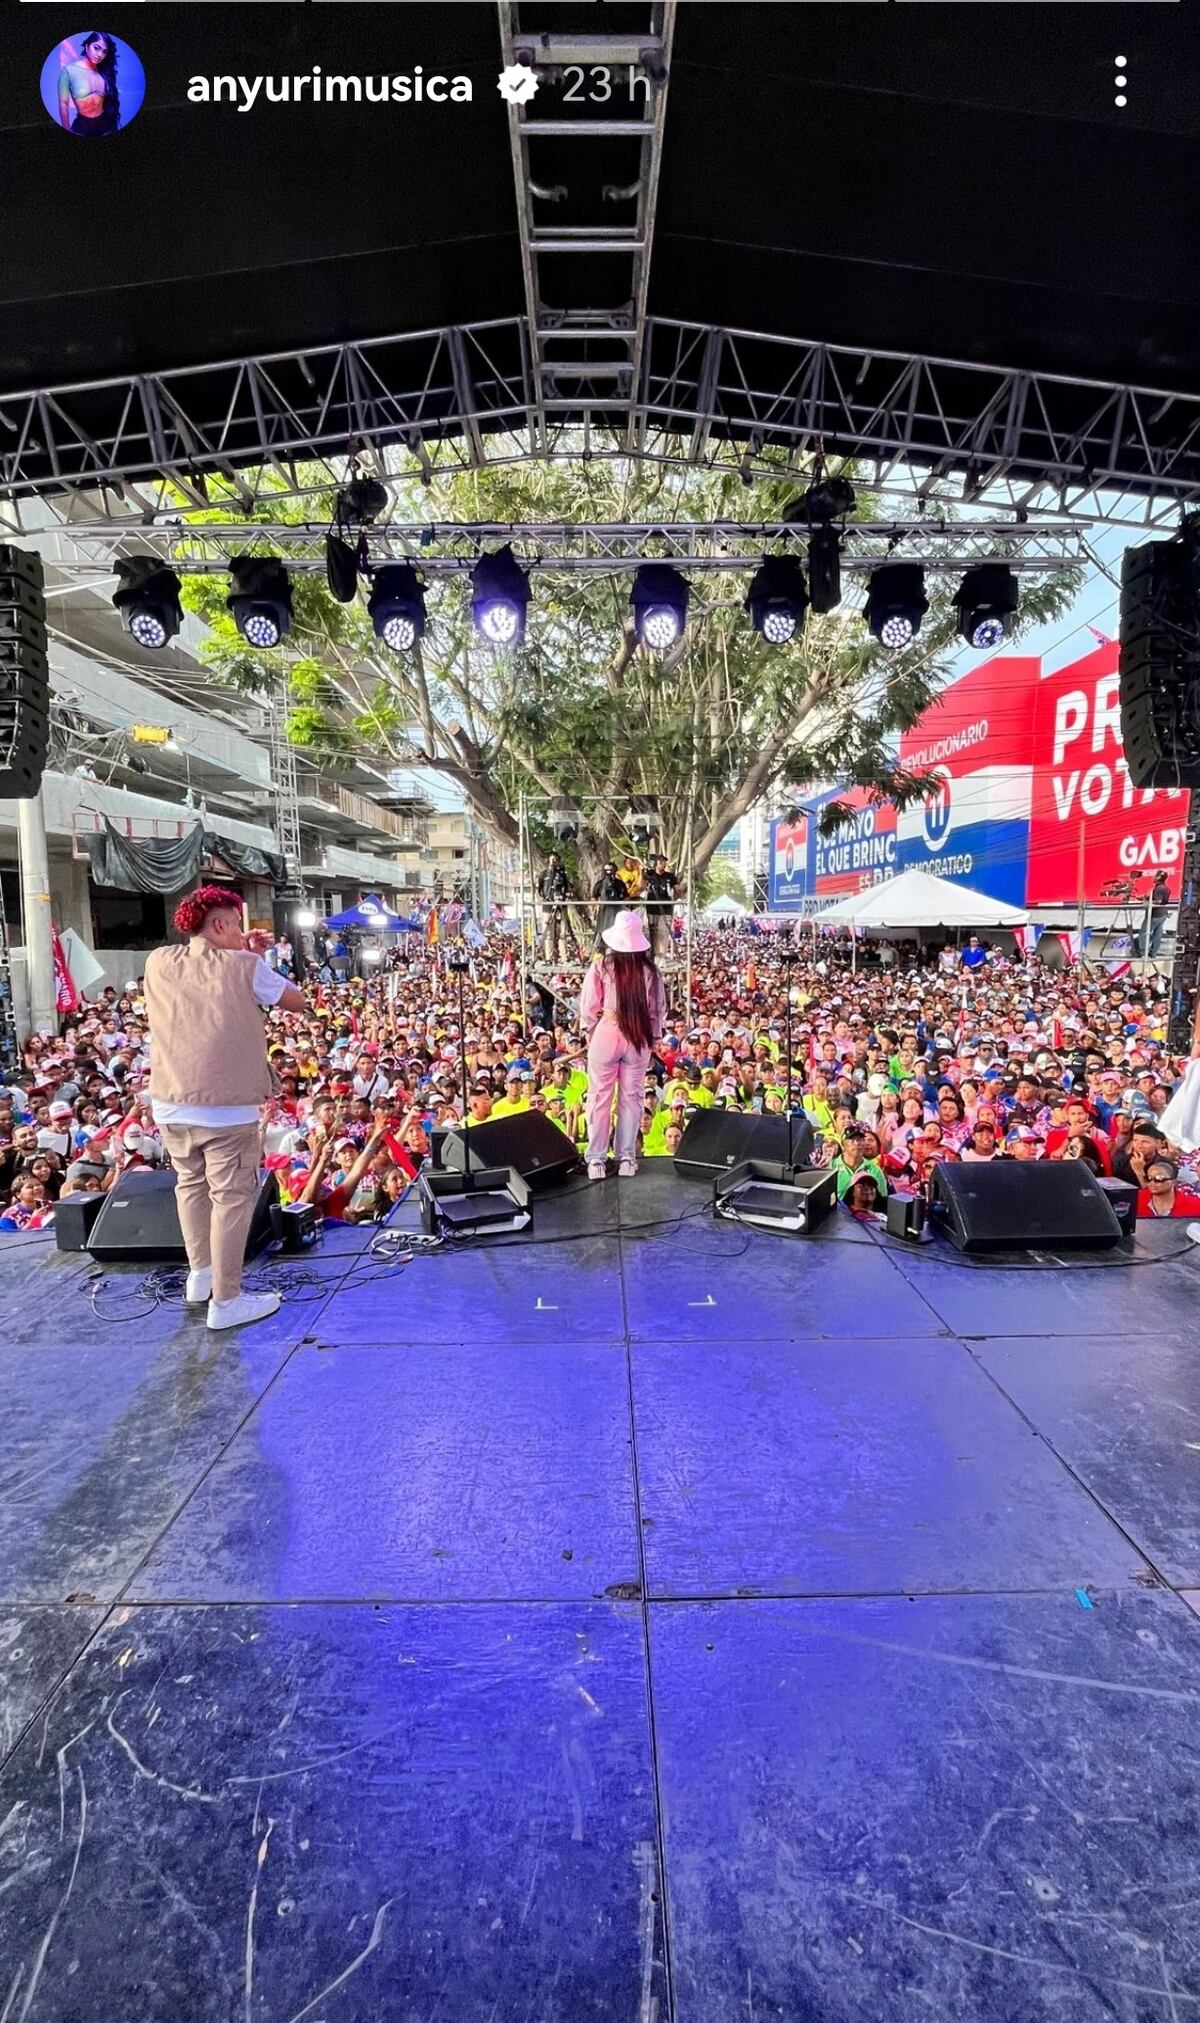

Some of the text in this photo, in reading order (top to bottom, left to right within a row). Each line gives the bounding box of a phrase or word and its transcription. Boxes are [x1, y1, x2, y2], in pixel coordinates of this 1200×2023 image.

[815, 834, 898, 875] EL QUE BRINC
